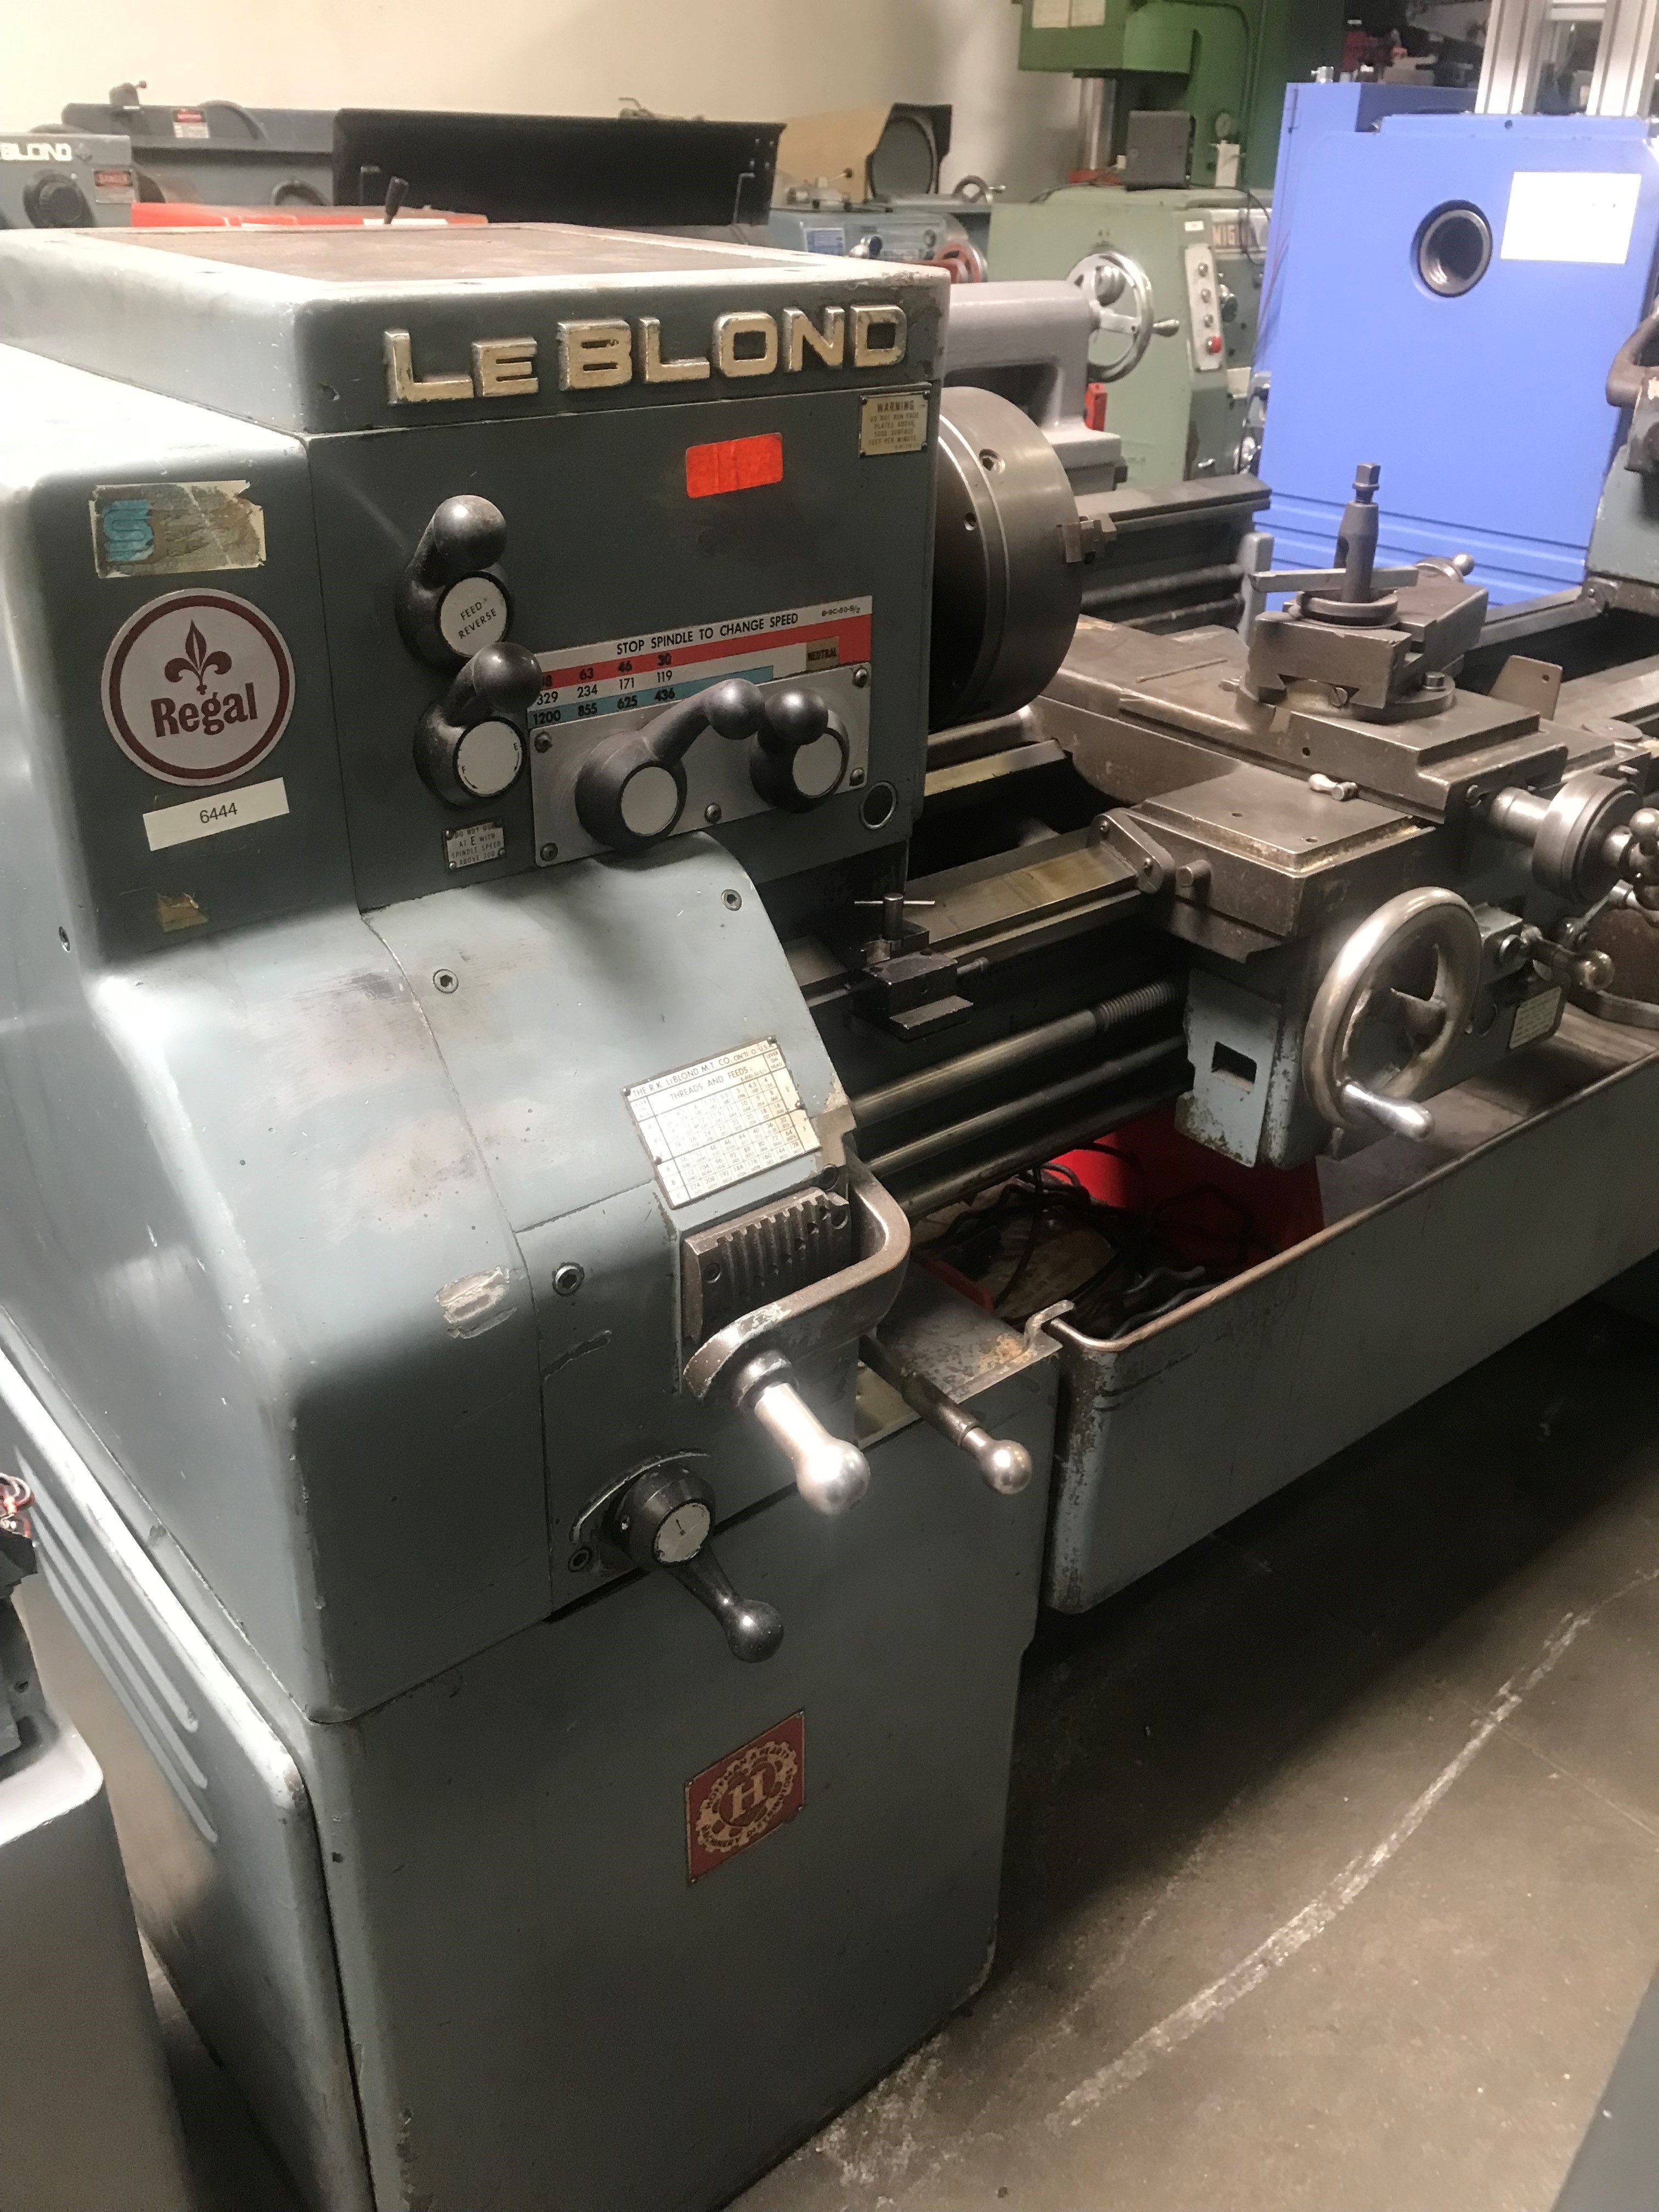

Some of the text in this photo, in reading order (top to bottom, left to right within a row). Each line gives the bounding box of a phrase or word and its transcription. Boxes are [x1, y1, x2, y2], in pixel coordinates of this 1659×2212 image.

[878, 400, 914, 412] WARNING
[460, 601, 483, 620] FEED
[458, 607, 497, 639] REVERSE
[617, 639, 645, 655] STOP
[651, 631, 693, 648] SPINDLE
[699, 628, 714, 640] TO
[720, 618, 764, 636] CHANGE
[770, 613, 798, 628] SPEED
[579, 668, 594, 680] 63
[537, 670, 673, 706] 329 234 171 119
[150, 681, 259, 738] Regal
[533, 709, 561, 725] 1200
[578, 702, 597, 717] 855
[617, 695, 637, 709] 625
[513, 742, 519, 751] E
[461, 765, 466, 774] F
[199, 803, 238, 825] 6444
[467, 826, 480, 836] NOT
[470, 836, 476, 846] E
[479, 833, 495, 842] WITH
[451, 840, 501, 859] SPINDLE SPEED
[633, 1087, 647, 1097] THE
[670, 1083, 703, 1099] THREADS
[706, 1075, 724, 1086] AND
[727, 1066, 748, 1079] FEEDS
[747, 1081, 757, 1089] 4.5
[689, 1182, 700, 1190] 224
[704, 1176, 715, 1184] 208
[728, 1768, 768, 1822] H
